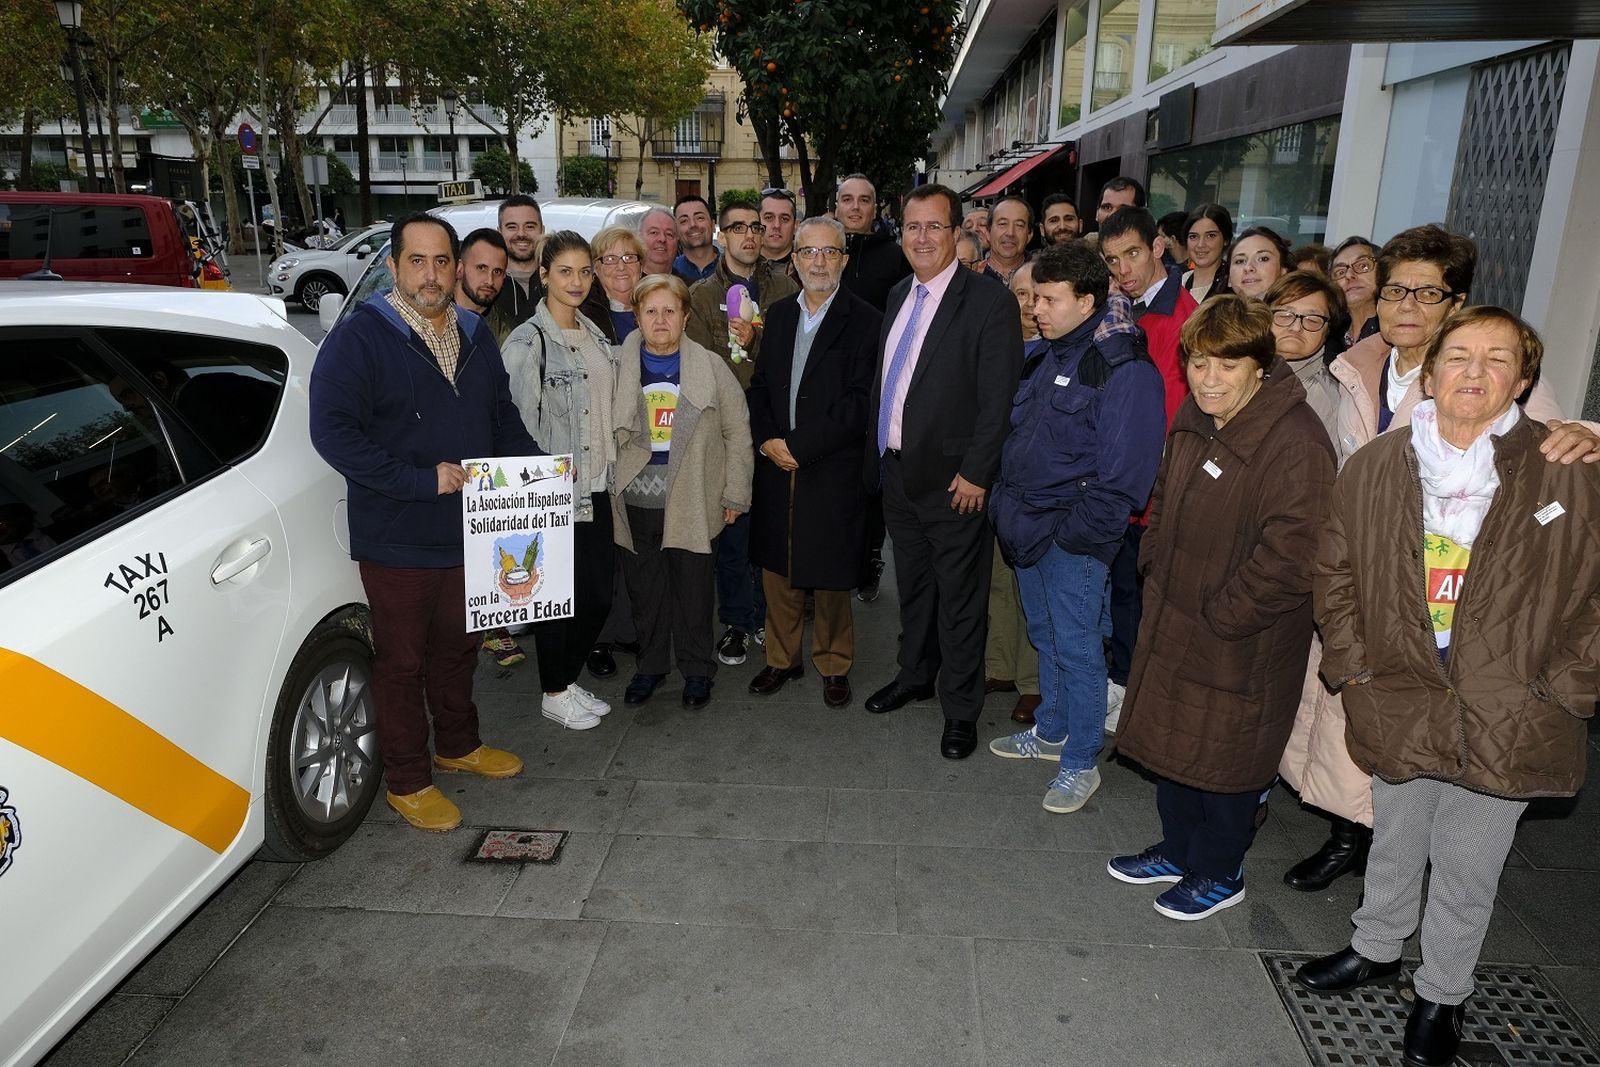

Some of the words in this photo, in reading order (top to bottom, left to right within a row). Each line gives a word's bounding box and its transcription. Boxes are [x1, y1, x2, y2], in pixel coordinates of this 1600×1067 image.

[444, 183, 467, 197] TAXI
[466, 496, 477, 513] La
[479, 491, 526, 512] Asociación
[527, 490, 572, 511] Hispalense
[531, 512, 547, 530] del
[103, 552, 168, 594] TAXI
[133, 578, 169, 620] 267
[468, 594, 488, 608] con
[490, 590, 500, 605] la
[470, 605, 528, 629] Tercera
[533, 597, 572, 620] Edad
[158, 615, 175, 643] A
